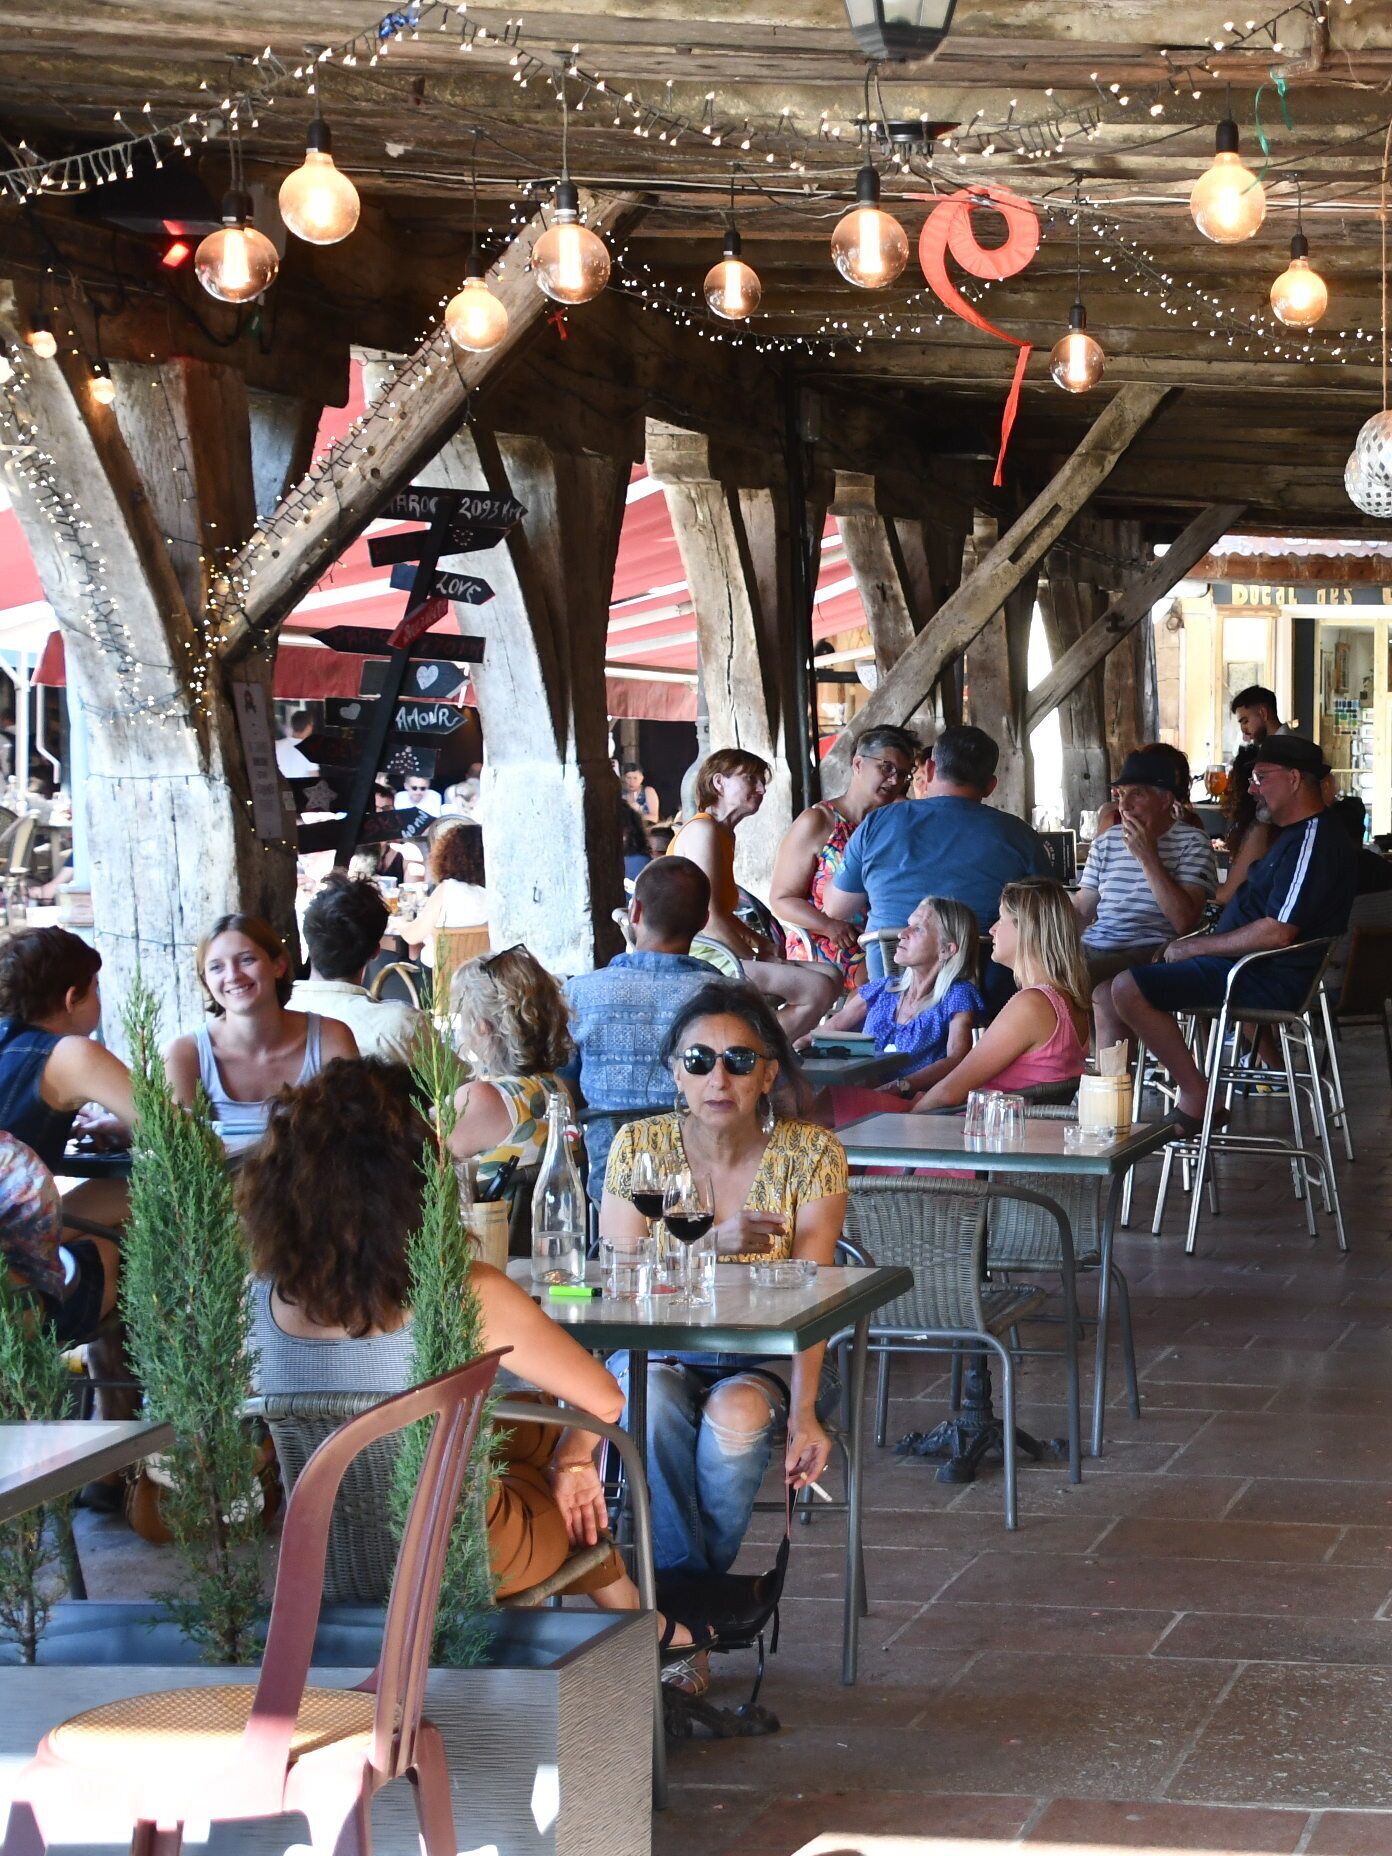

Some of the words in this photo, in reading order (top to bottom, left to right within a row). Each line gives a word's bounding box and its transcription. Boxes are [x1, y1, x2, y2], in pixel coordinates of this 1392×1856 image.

[459, 496, 499, 520] 2093
[436, 571, 482, 604] LOVE
[394, 704, 460, 732] AMOUR
